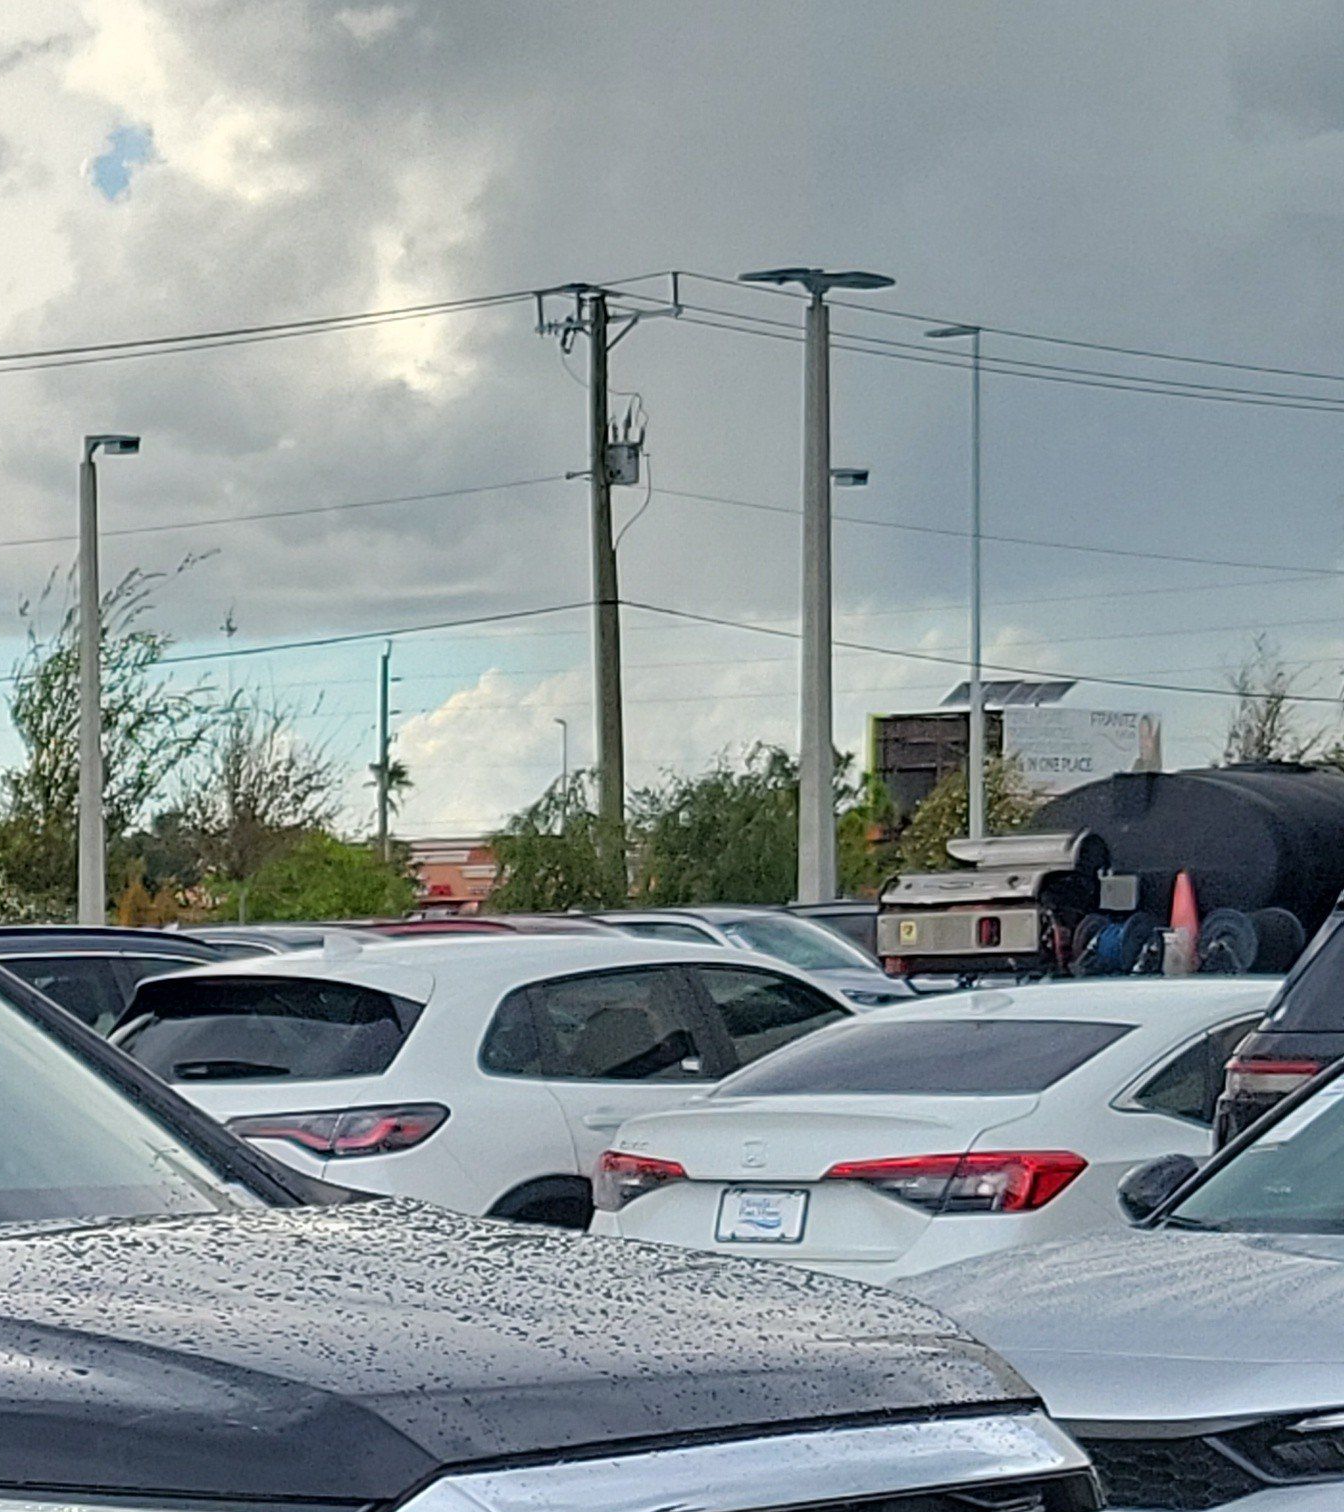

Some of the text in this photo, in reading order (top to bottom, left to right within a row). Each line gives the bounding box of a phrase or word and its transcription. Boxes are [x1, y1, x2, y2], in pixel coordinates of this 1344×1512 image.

[1091, 711, 1138, 728] FRANTZ
[1039, 757, 1060, 772] ONE
[1061, 757, 1093, 772] PLACE
